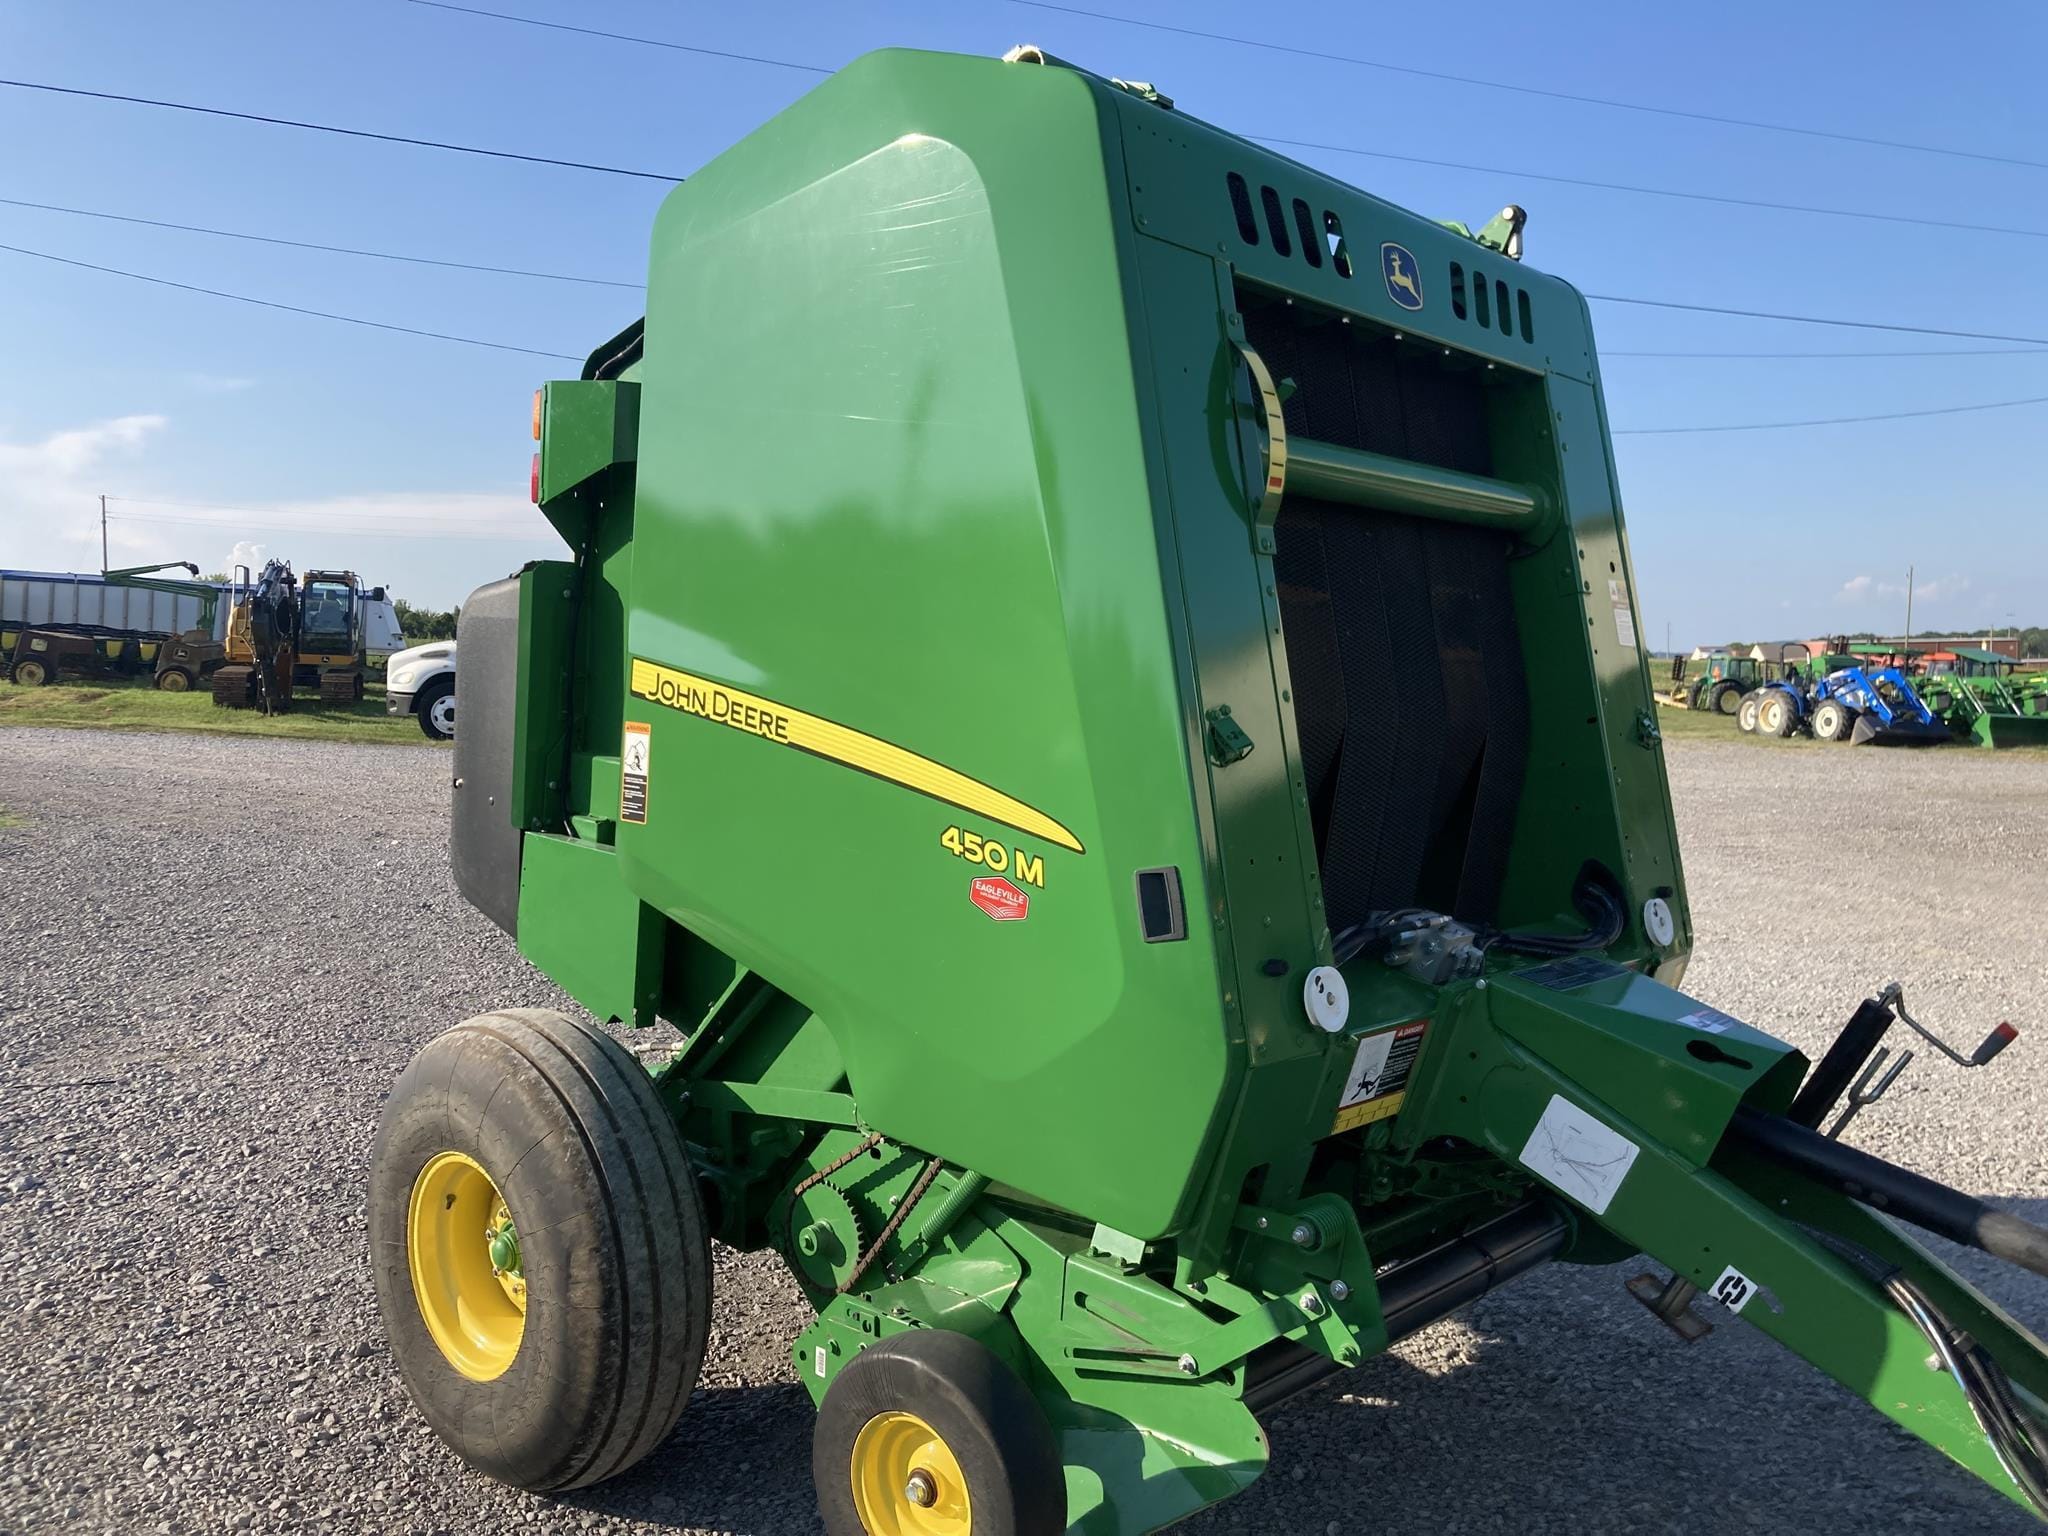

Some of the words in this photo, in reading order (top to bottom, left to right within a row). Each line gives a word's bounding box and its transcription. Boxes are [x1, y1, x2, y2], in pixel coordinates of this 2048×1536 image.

[648, 673, 706, 712] JOHN
[712, 690, 789, 740] DEERE
[940, 825, 1009, 873] 450
[1014, 847, 1045, 889] M
[975, 881, 1025, 904] EAGLEVILLE
